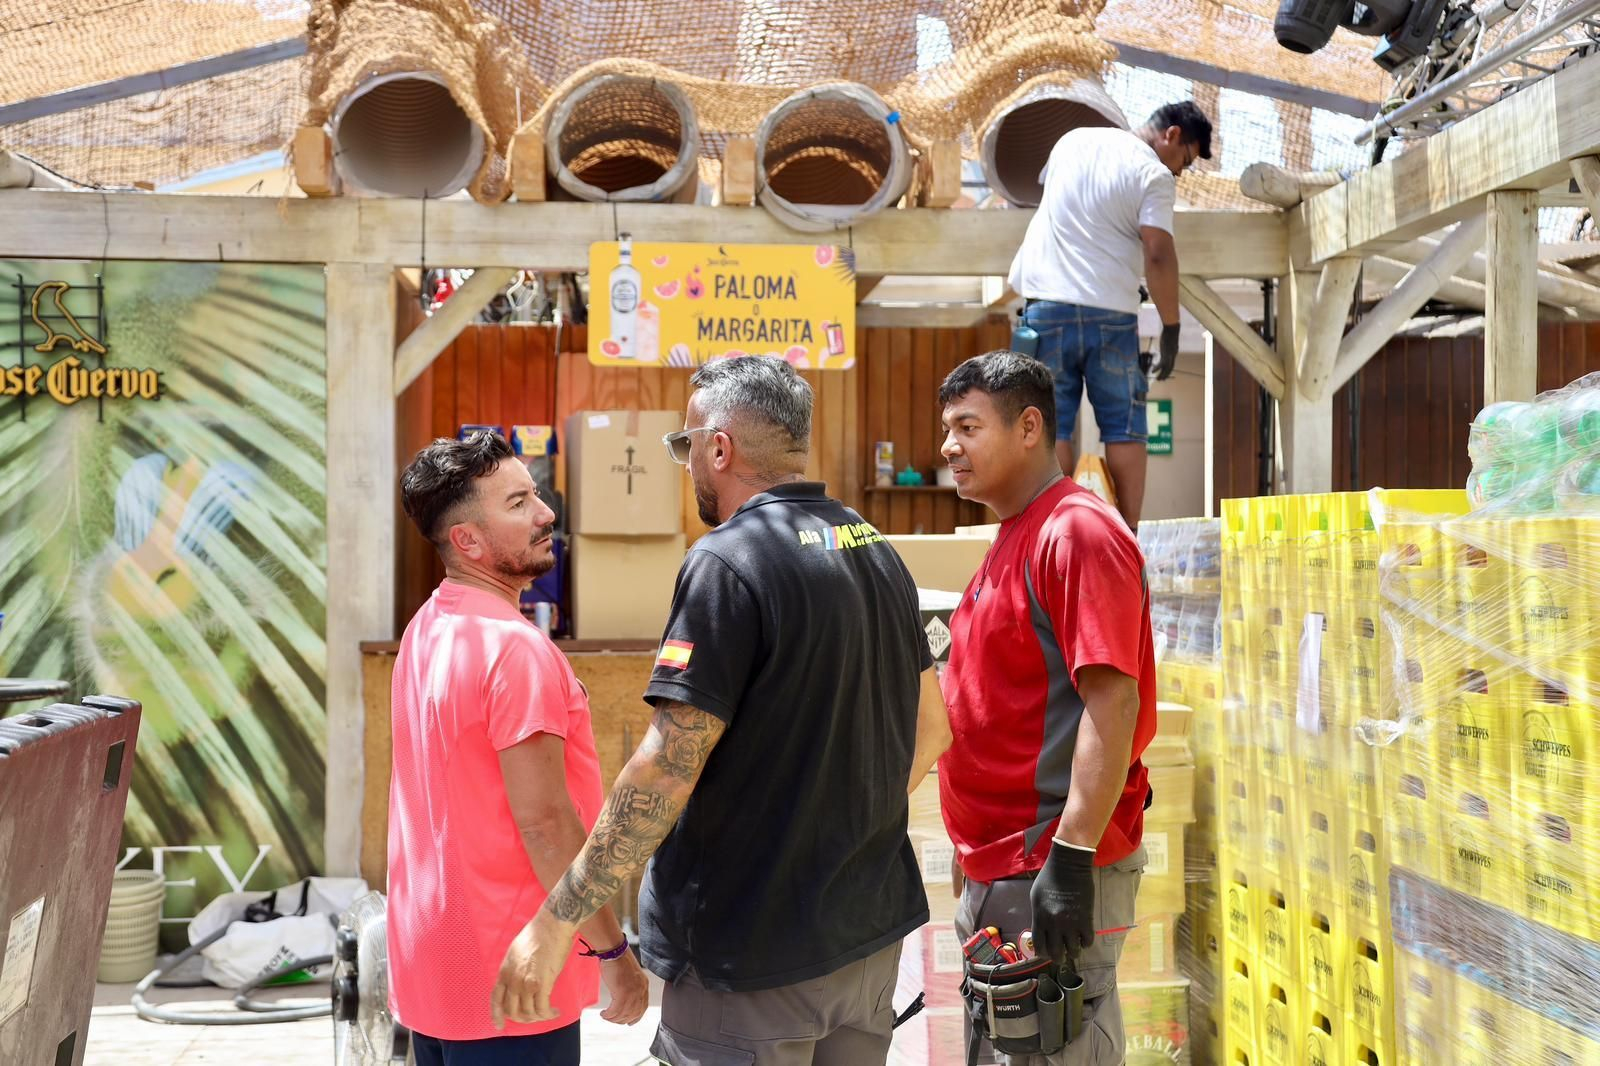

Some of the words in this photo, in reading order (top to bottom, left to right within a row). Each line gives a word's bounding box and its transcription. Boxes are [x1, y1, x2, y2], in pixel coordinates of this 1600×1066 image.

[714, 273, 797, 300] PALOMA
[697, 316, 814, 343] MARGARITA
[47, 354, 158, 405] Cuervo
[1532, 738, 1571, 758] SCHWEPPES
